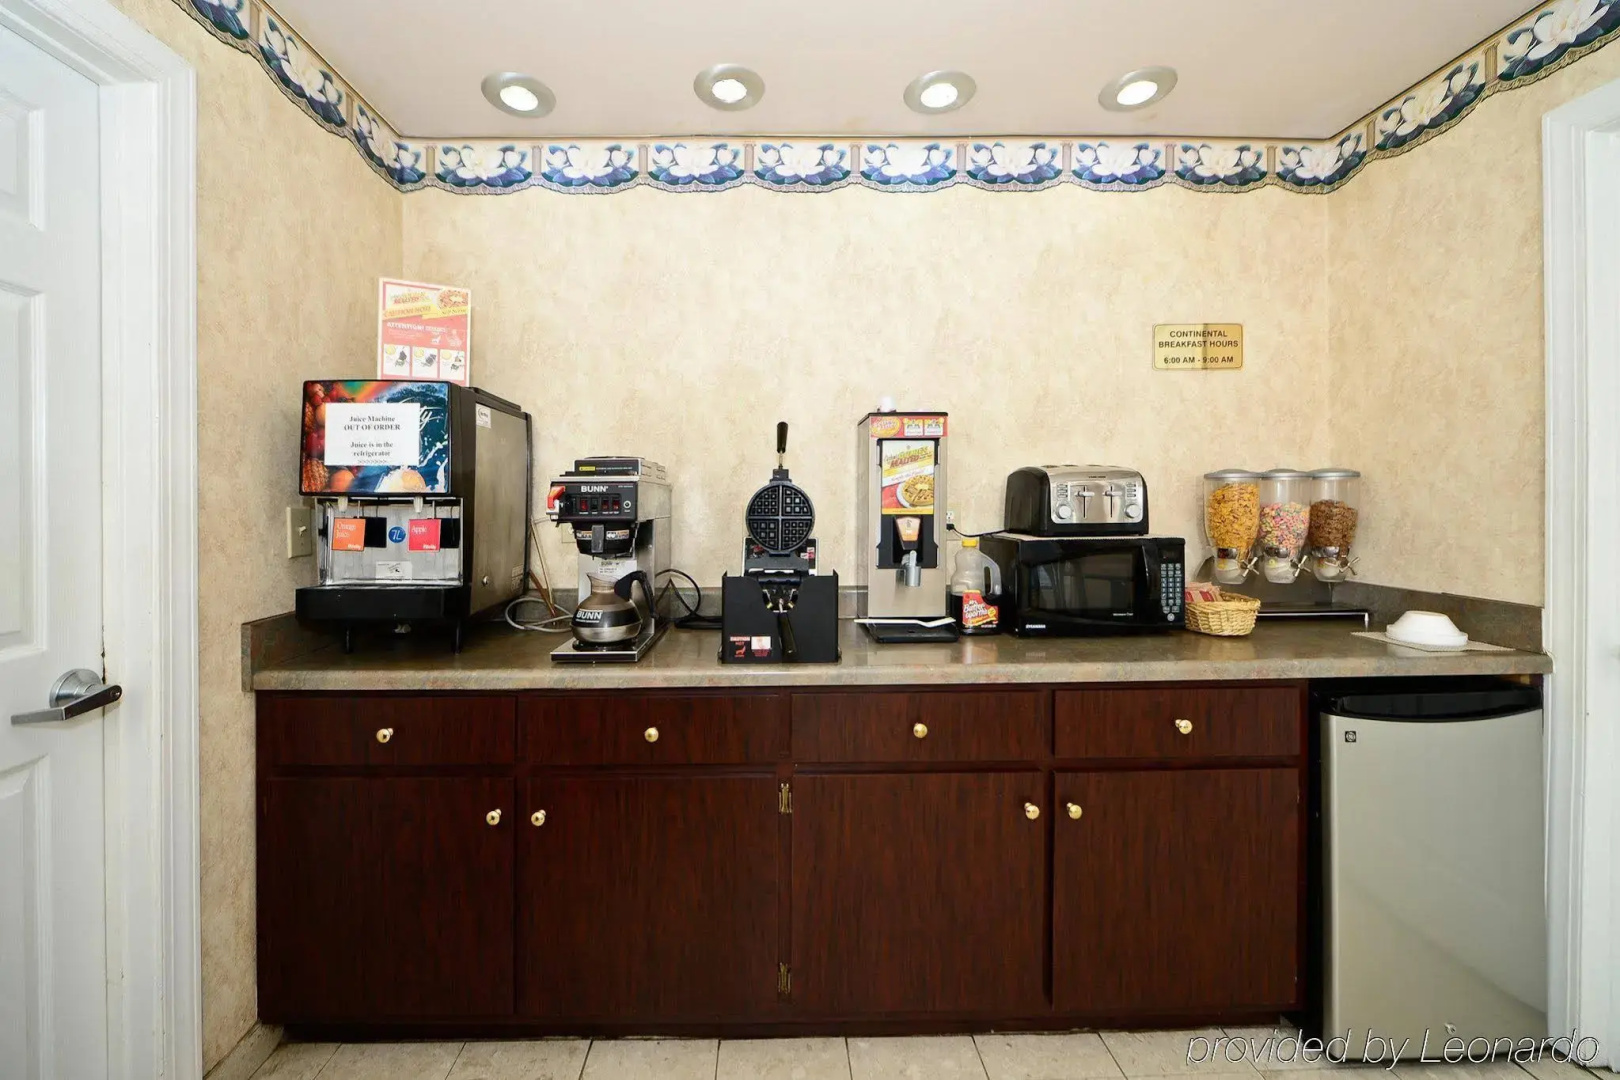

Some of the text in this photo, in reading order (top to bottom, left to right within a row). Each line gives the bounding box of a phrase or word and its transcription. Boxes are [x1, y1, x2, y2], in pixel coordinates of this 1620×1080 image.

[1169, 330, 1228, 338] CONTINENTAL
[1158, 340, 1239, 348] BREAKFAST HOURS
[1163, 356, 1181, 364] 6:00
[1182, 356, 1195, 364] AM
[1202, 356, 1219, 364] 9:00
[580, 485, 607, 493] BUNN
[576, 610, 602, 620] BUNN
